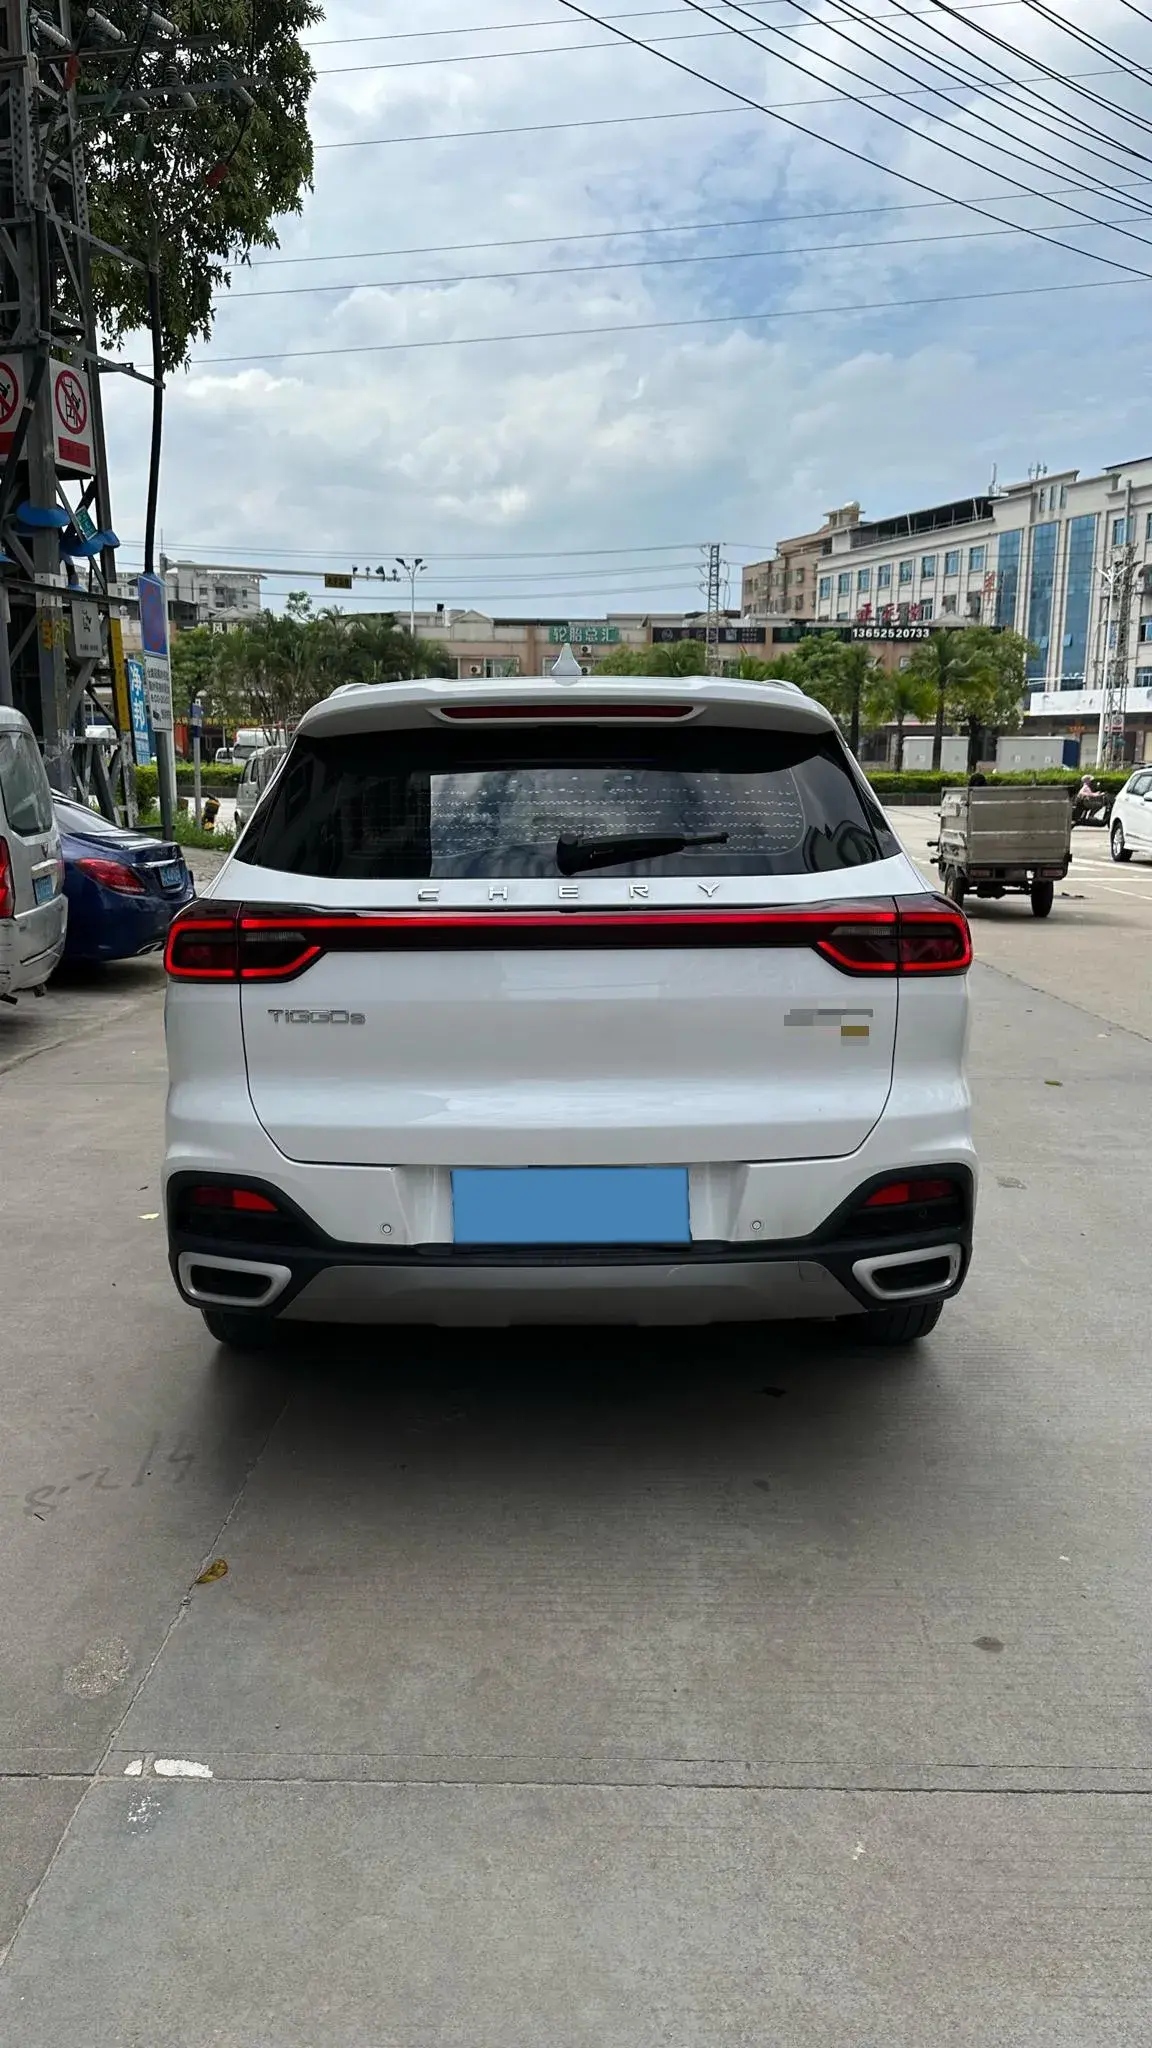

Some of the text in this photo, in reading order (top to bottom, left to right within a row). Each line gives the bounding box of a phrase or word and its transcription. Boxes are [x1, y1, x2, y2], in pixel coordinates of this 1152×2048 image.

[552, 626, 615, 642] 轮胎总汇
[852, 628, 930, 639] 13652520733
[417, 882, 721, 901] CHERY
